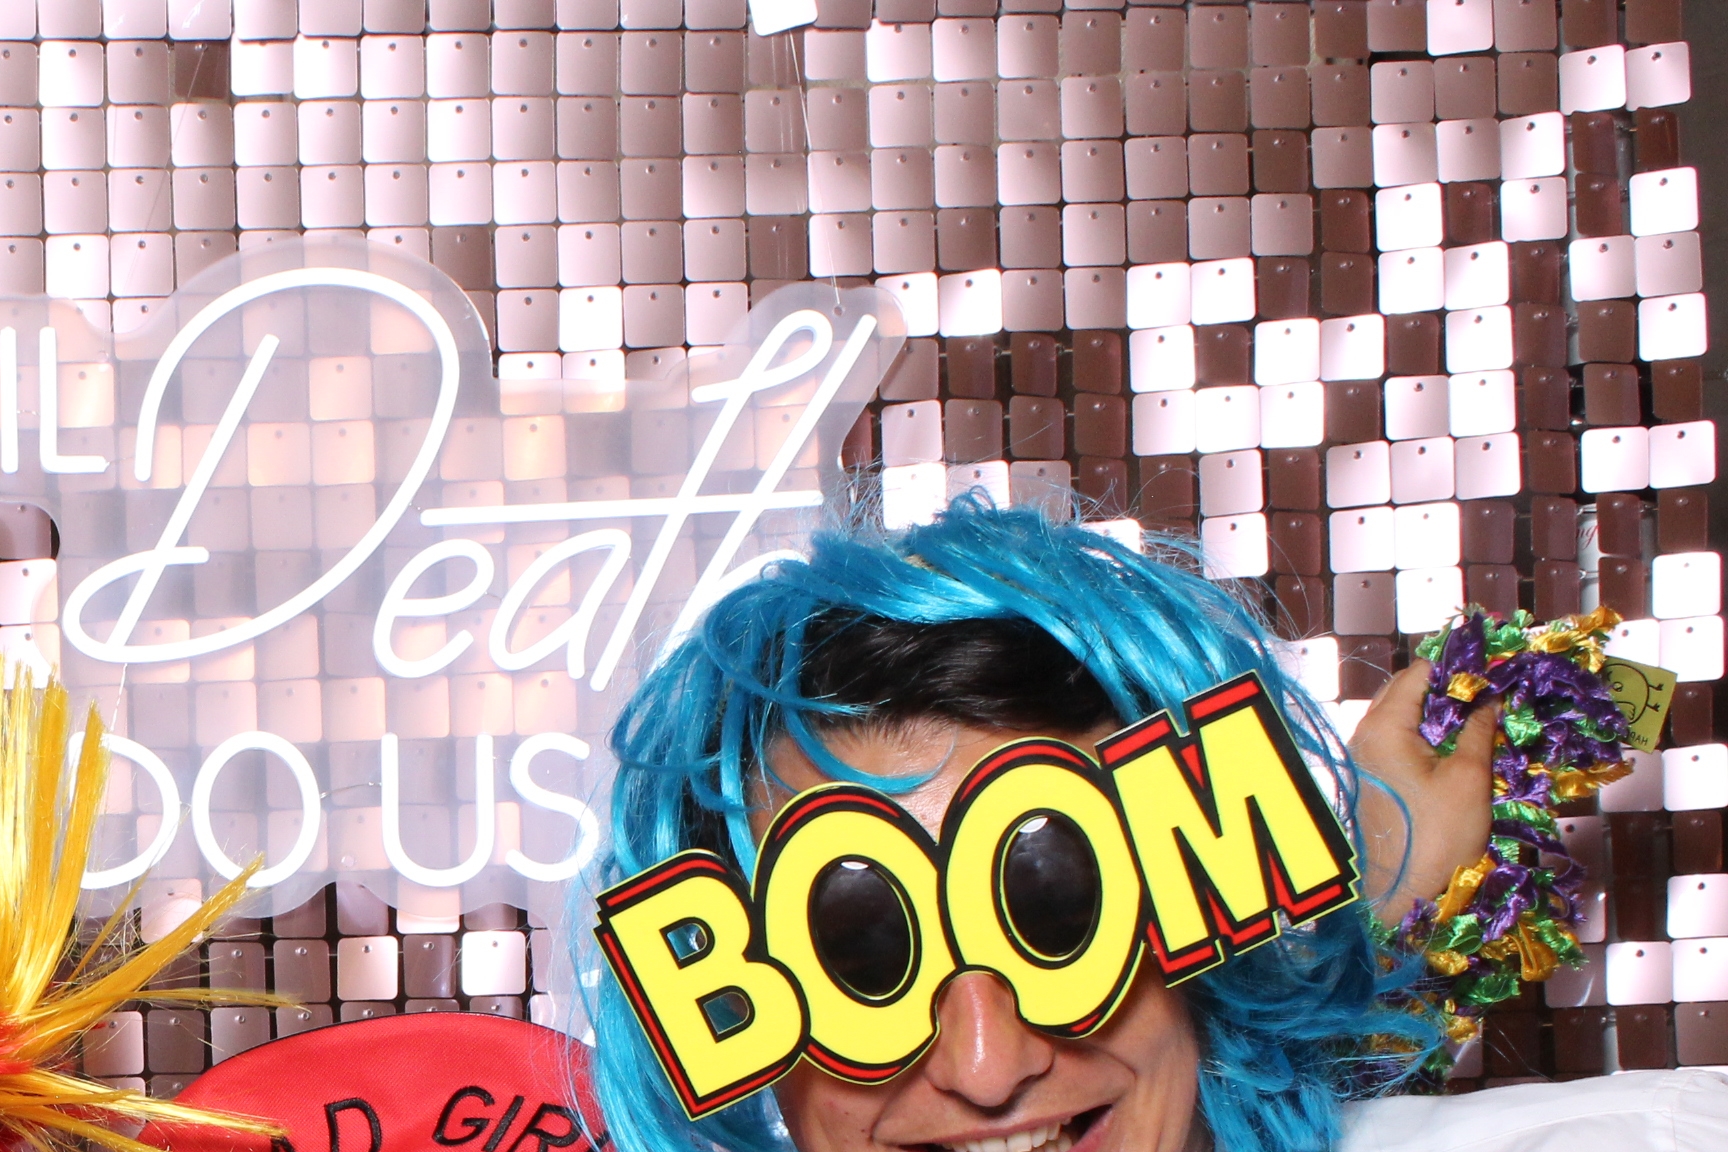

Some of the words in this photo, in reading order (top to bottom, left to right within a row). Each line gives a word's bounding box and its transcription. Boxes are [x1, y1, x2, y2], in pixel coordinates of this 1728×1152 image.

[68, 729, 321, 890] DO
[380, 730, 600, 889] US
[592, 669, 1359, 1121] BOOM
